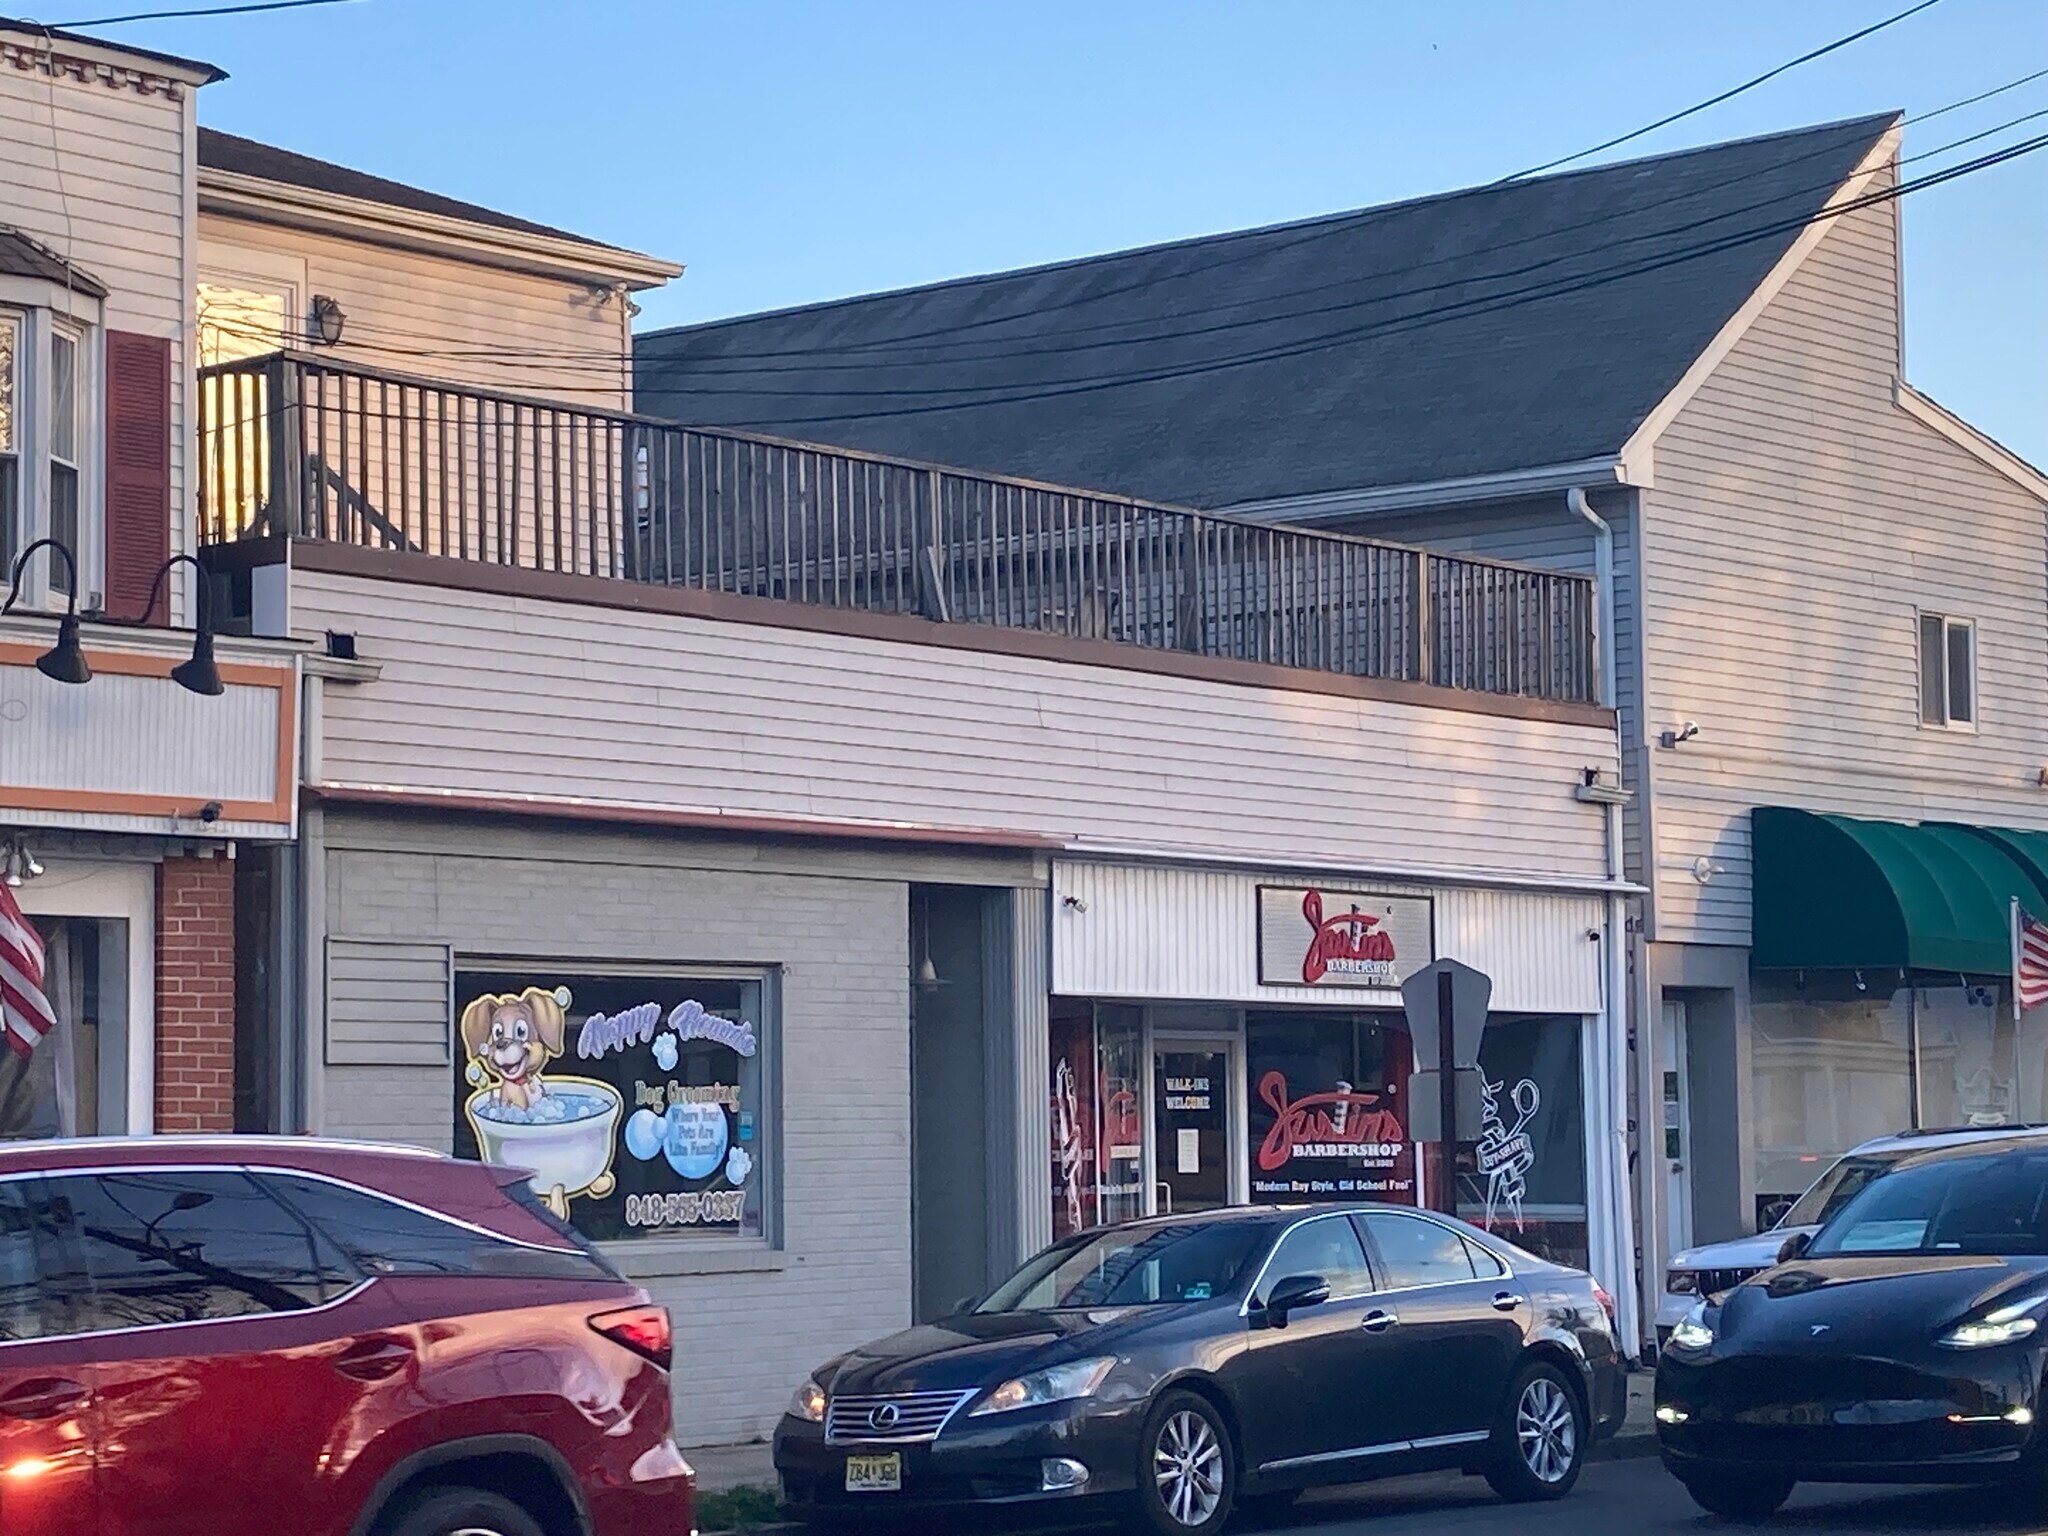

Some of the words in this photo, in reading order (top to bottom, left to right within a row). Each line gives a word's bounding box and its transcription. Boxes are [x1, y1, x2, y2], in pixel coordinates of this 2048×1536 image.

[1327, 959, 1395, 974] BARBERSHOP
[635, 1080, 665, 1114] Dog
[1165, 1096, 1211, 1110] WELCOME
[1292, 1143, 1403, 1158] BARBERSHOP
